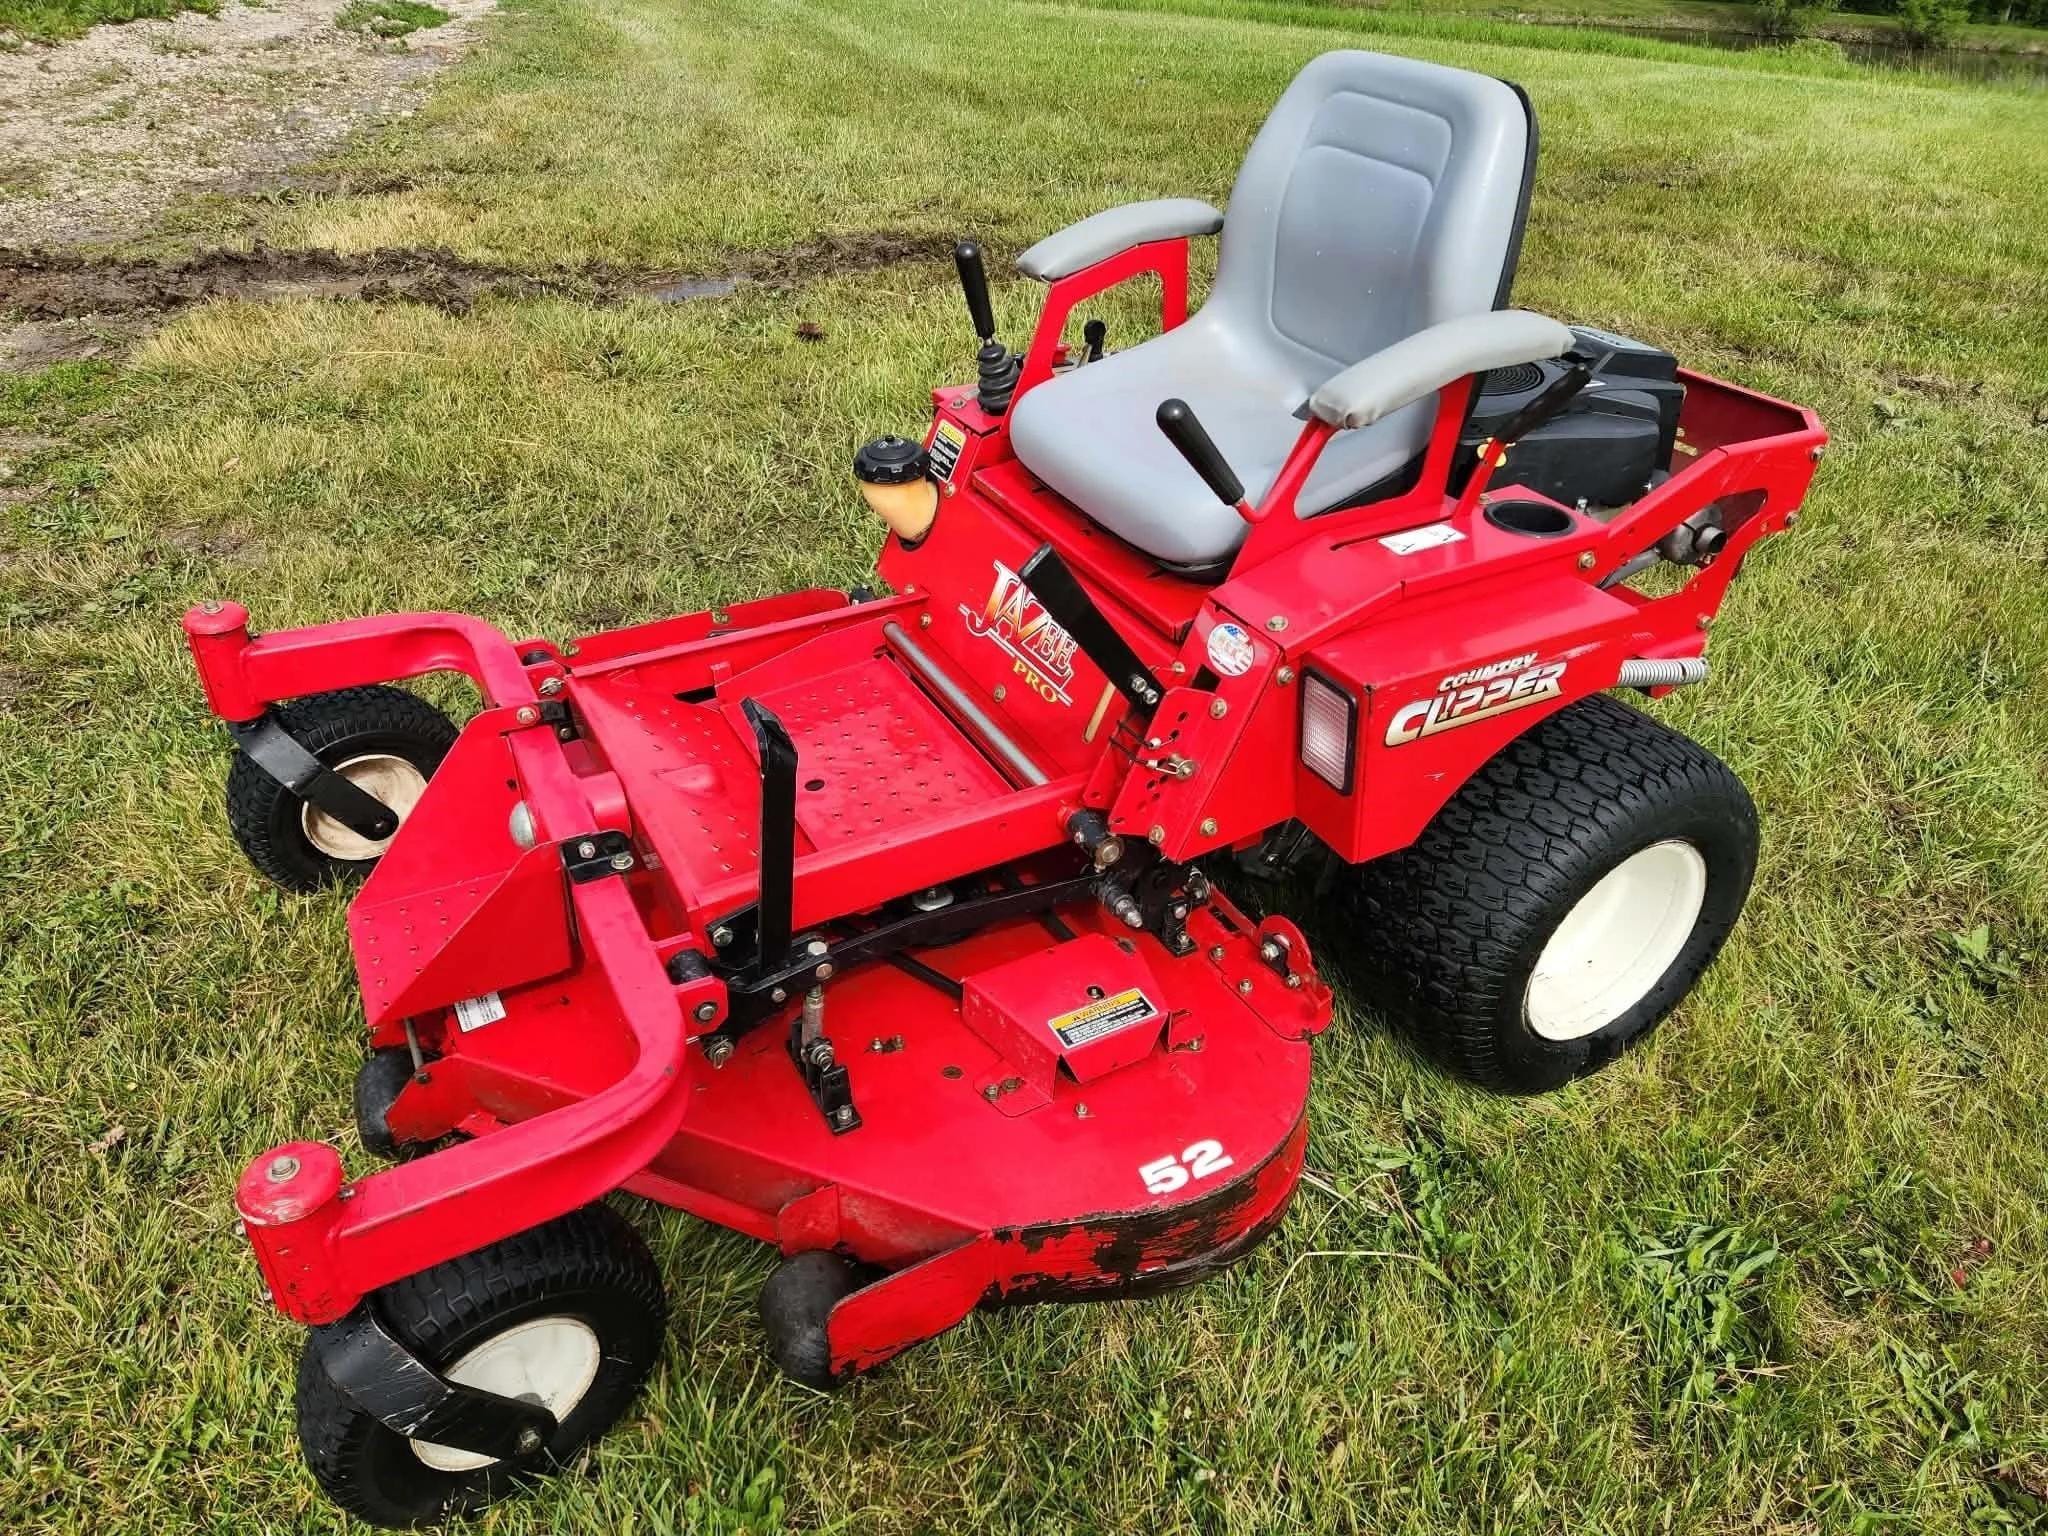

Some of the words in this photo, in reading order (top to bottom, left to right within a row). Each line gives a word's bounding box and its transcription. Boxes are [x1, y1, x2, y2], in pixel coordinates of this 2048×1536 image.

[1013, 659, 1057, 703] PRO
[1438, 652, 1538, 692] COUNTRY
[1385, 662, 1567, 746] CLIPPER
[1138, 1139, 1235, 1195] 52
